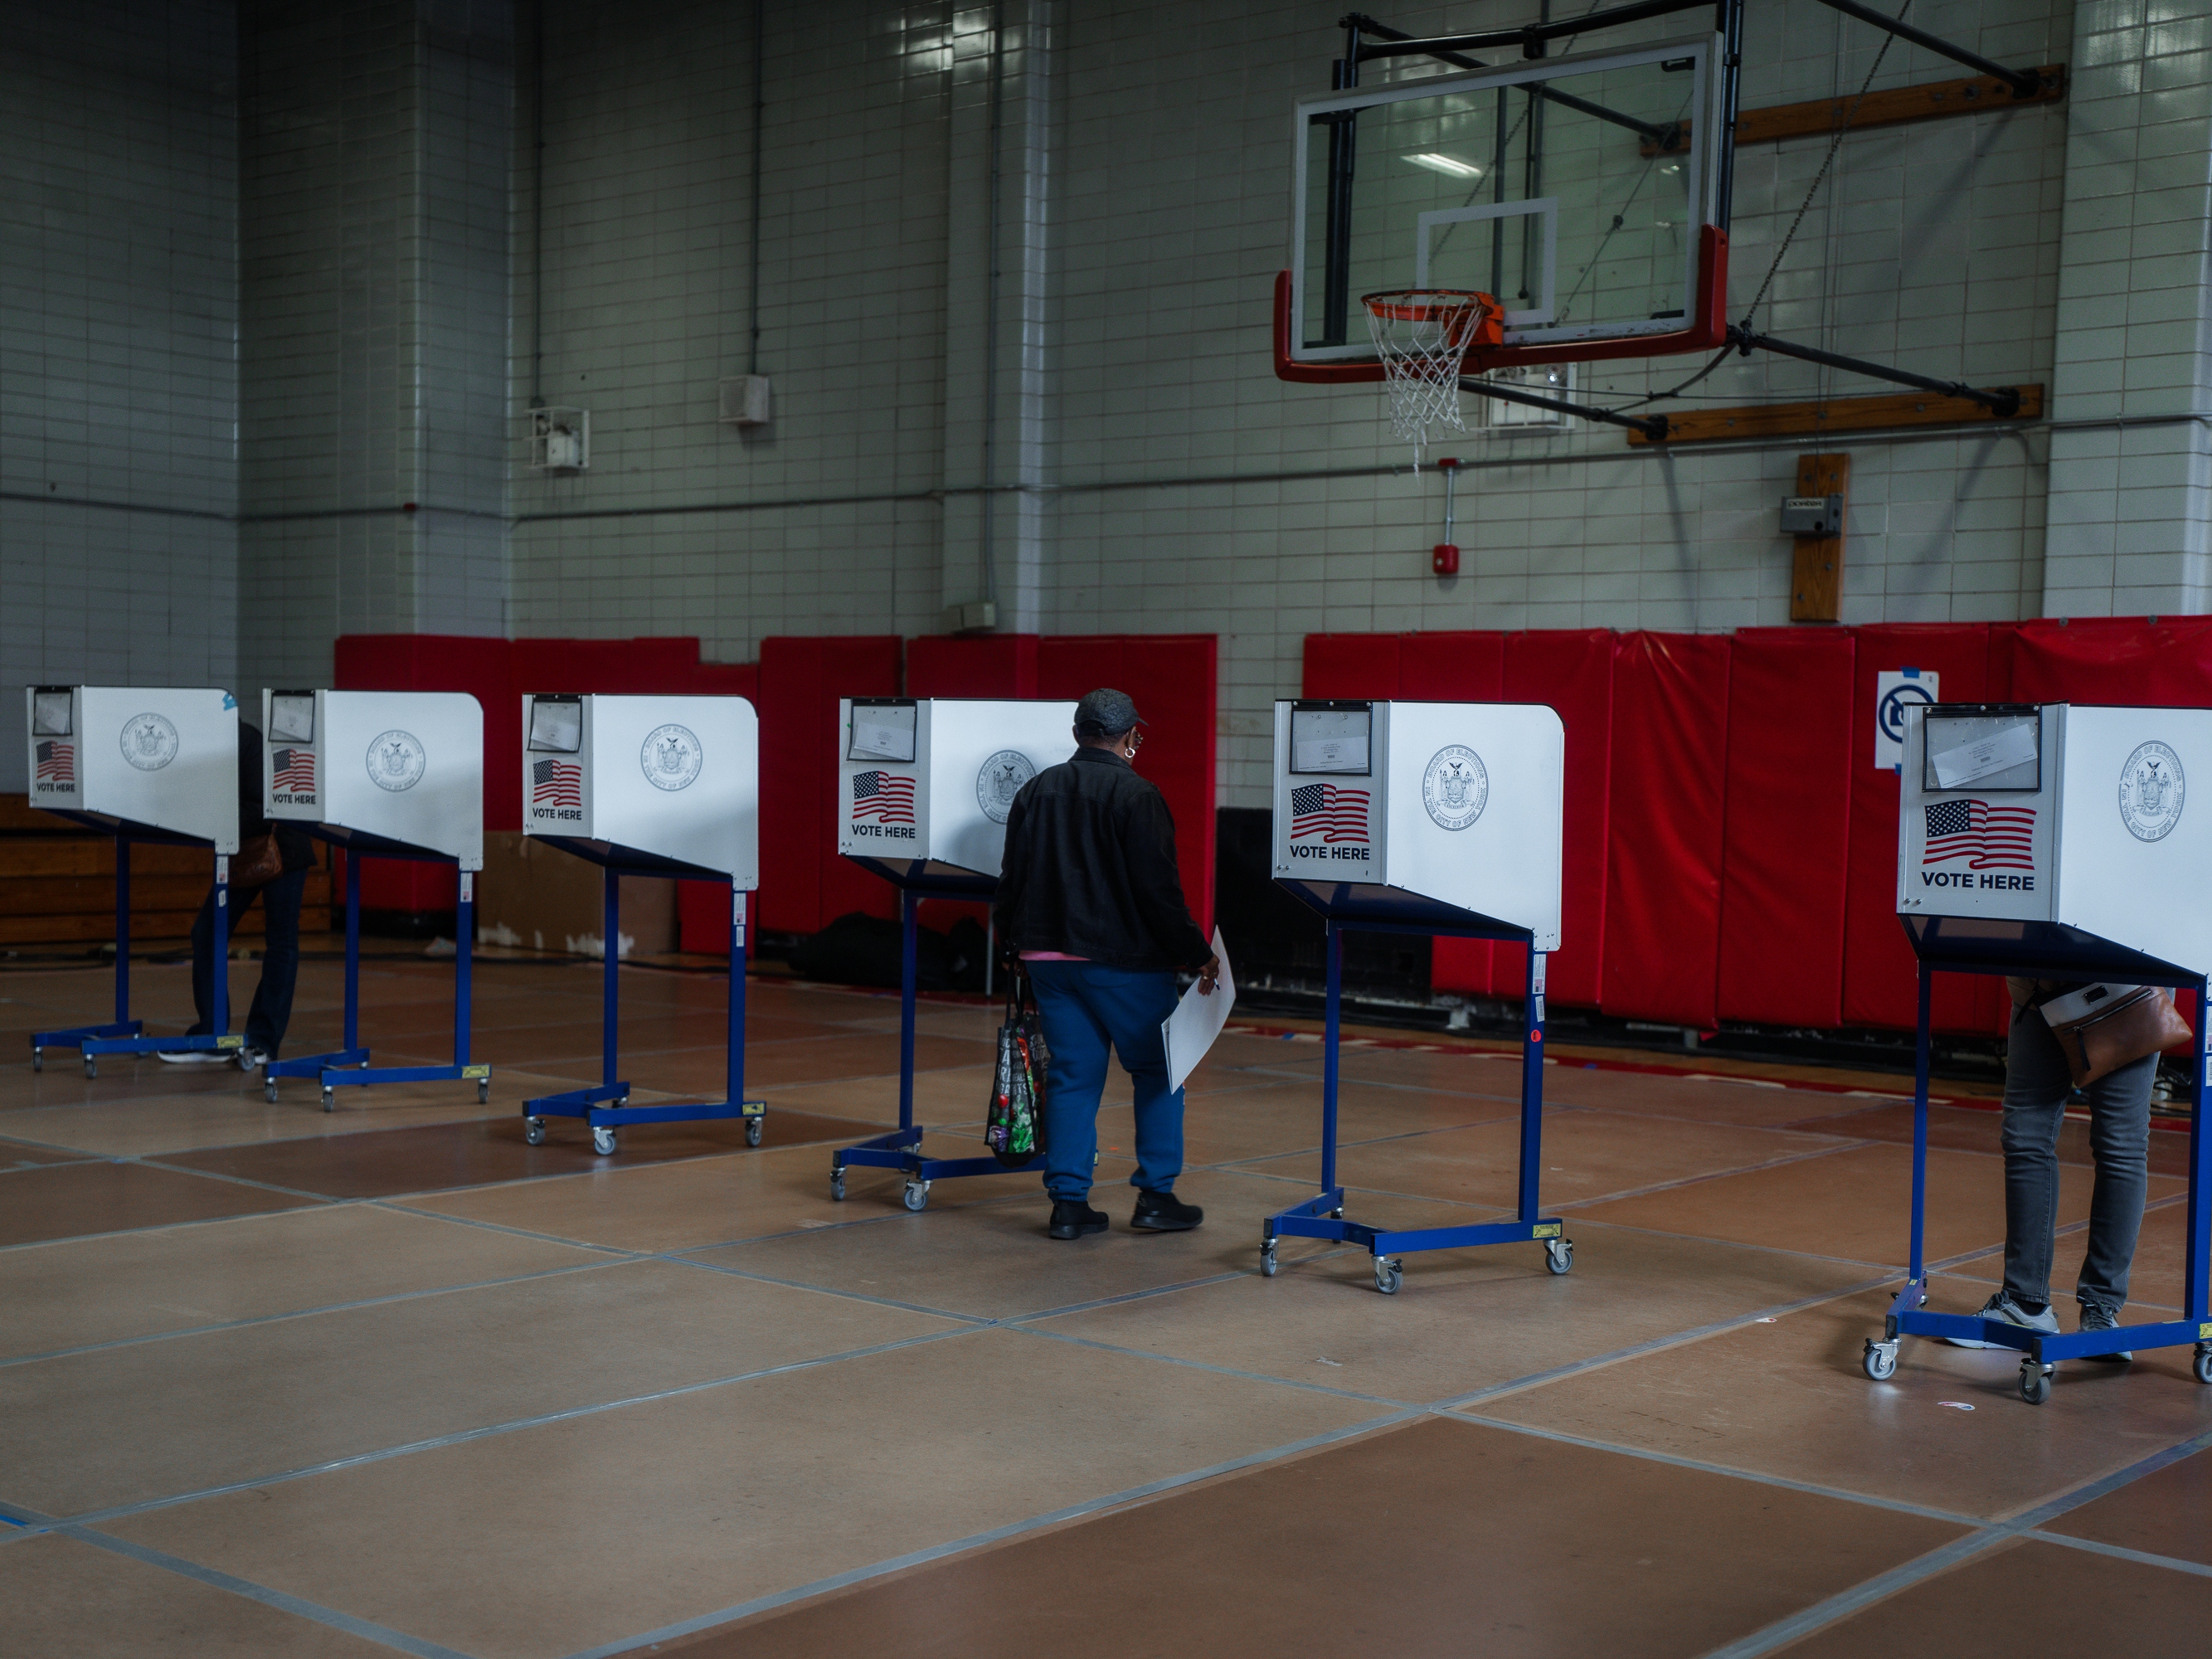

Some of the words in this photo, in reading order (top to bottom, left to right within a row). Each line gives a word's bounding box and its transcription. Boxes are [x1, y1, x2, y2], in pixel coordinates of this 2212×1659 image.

[1427, 753, 1445, 778] BOARD
[1446, 748, 1455, 757] OF
[1456, 748, 1485, 779] ELECTIONS
[2124, 750, 2143, 779] BOARD
[2143, 745, 2153, 754] OF
[2155, 745, 2182, 782] ELECTIONS
[36, 782, 55, 792] VOTE
[56, 782, 75, 793] HERE
[1425, 786, 1431, 796] IN
[273, 793, 293, 804] VOTE
[294, 794, 316, 805] HERE
[1475, 786, 1486, 810] YORK
[1427, 797, 1437, 815] THE
[532, 808, 556, 819] VOTE
[557, 810, 582, 820] HERE
[1436, 814, 1451, 826] CITY
[1462, 810, 1477, 825] NEW
[2122, 802, 2132, 823] THE
[2131, 821, 2146, 837] CITY
[2146, 830, 2156, 839] OF
[2158, 819, 2172, 836] NEW
[2171, 791, 2183, 819] YORK
[852, 825, 882, 836] VOTE
[885, 826, 916, 839] HERE
[1290, 845, 1327, 859] VOTE
[1331, 847, 1370, 860] HERE
[1921, 872, 1974, 888] VOTE
[1980, 874, 2035, 891] HERE
